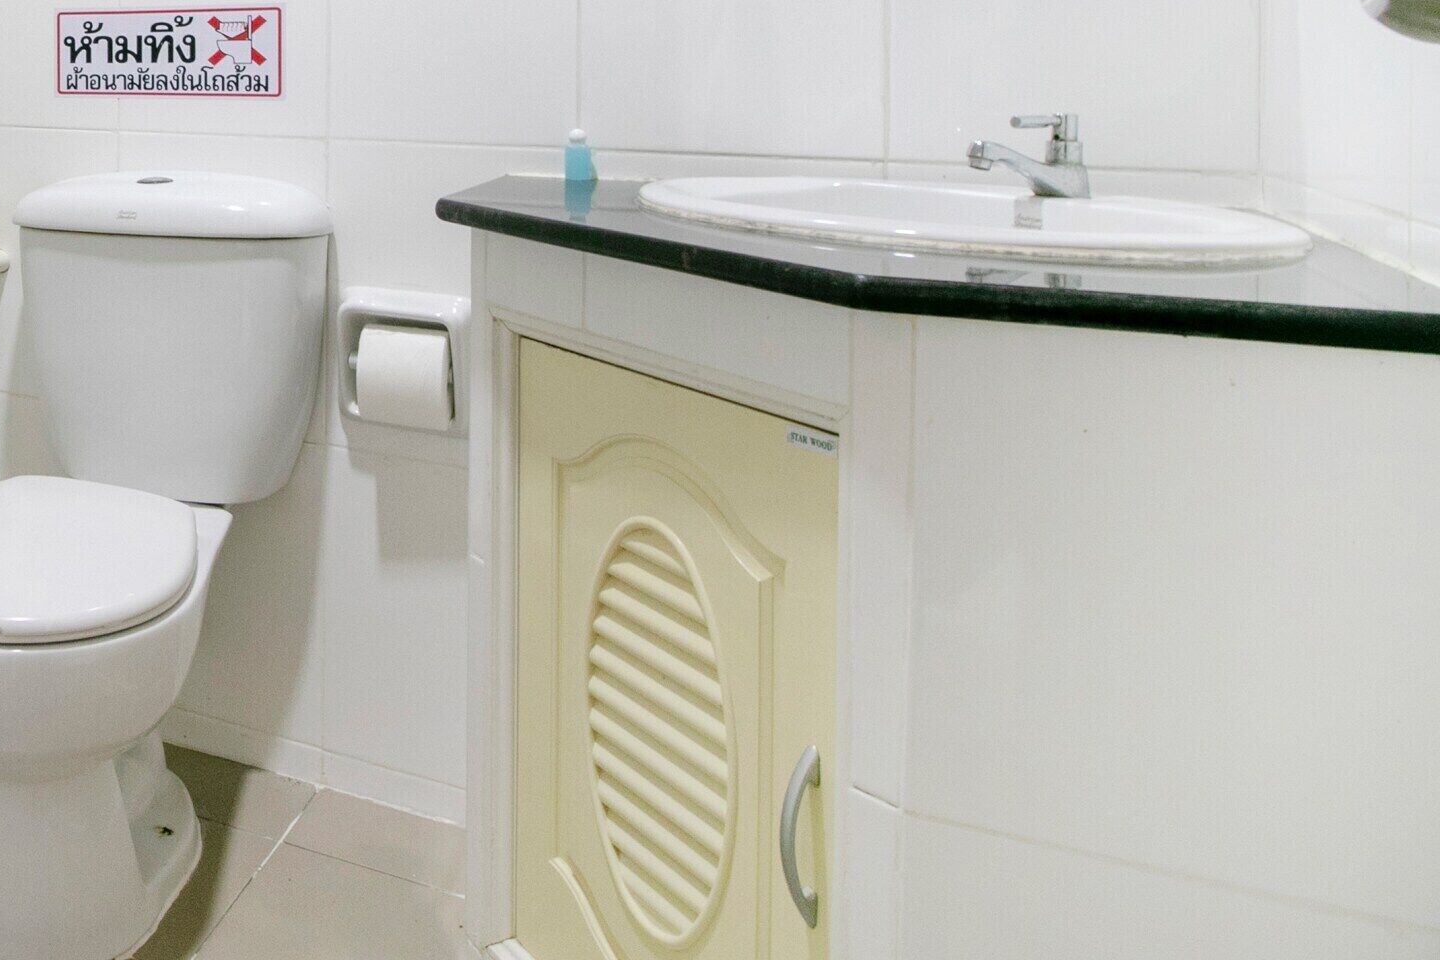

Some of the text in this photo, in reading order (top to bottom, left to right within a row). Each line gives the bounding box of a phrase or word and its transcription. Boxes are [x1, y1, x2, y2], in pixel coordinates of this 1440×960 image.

[63, 15, 196, 64] ห้ามทิ้ง
[66, 65, 269, 92] ผ้าอนามัยลงในโถส้วม
[790, 432, 833, 451] STAR WOOD
